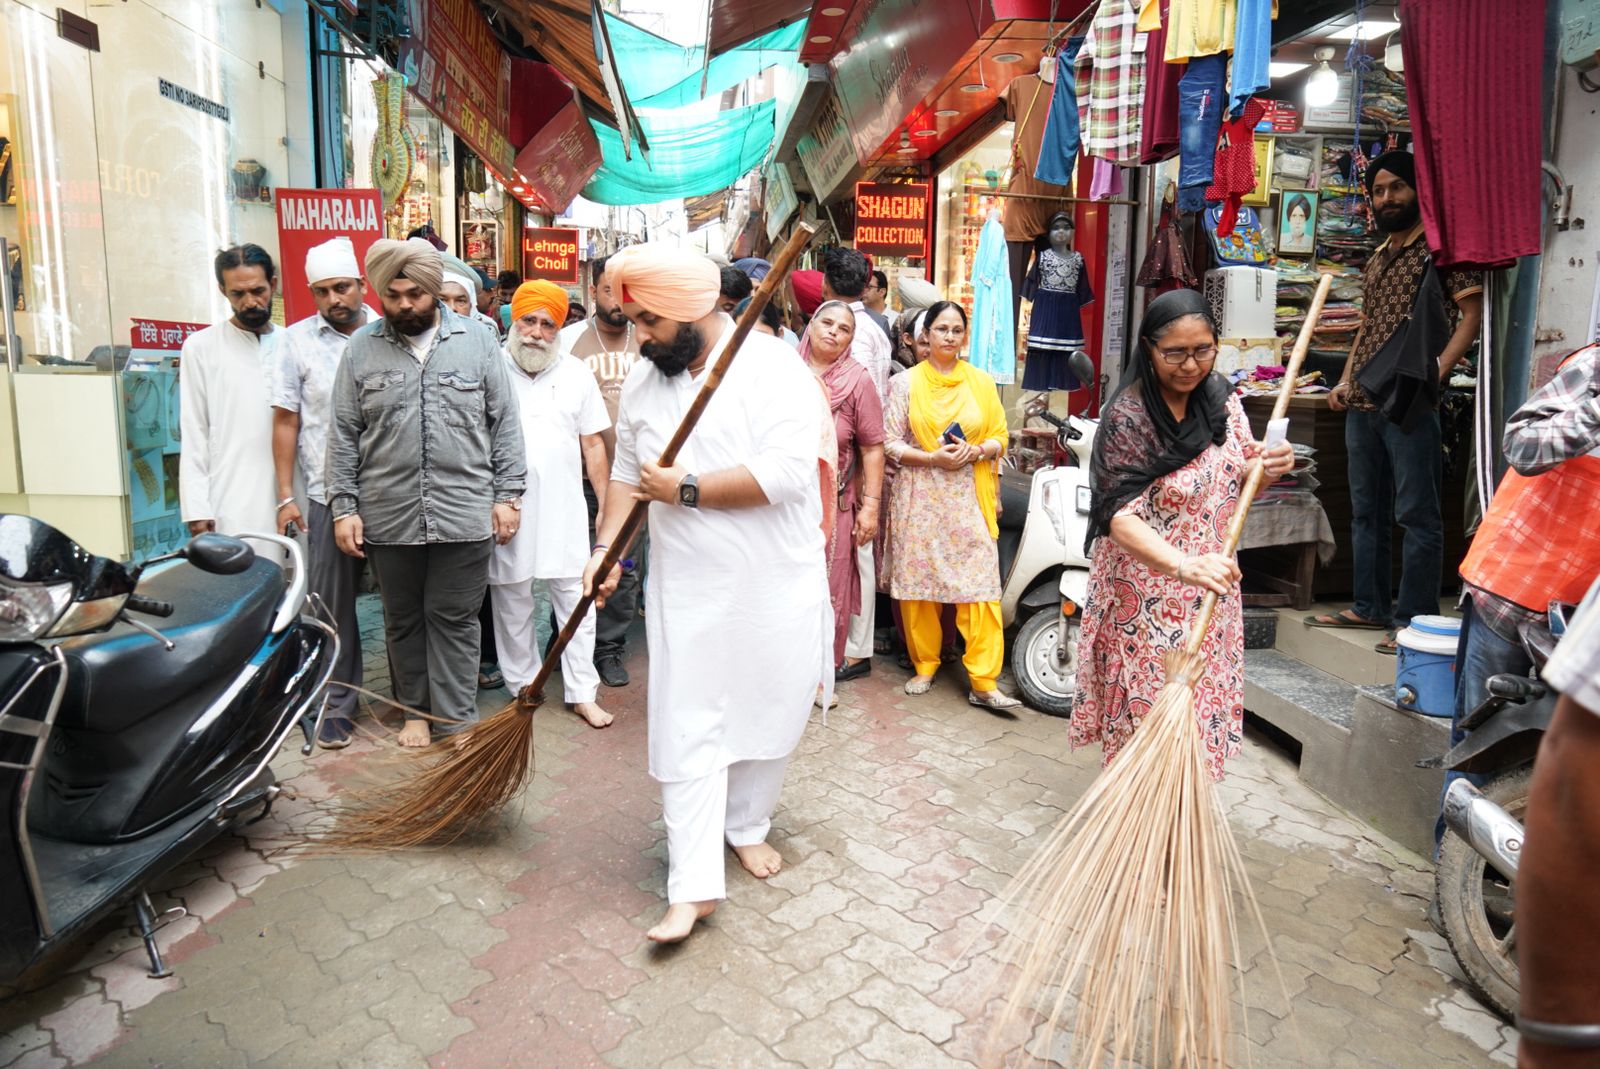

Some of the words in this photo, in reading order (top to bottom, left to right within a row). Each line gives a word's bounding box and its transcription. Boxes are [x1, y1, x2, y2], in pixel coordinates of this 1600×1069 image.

[281, 198, 379, 231] MAHARAJA
[858, 195, 925, 219] SHAGUN
[857, 226, 924, 244] COLLECTION
[526, 238, 576, 257] Lehnga
[534, 256, 569, 270] Choli
